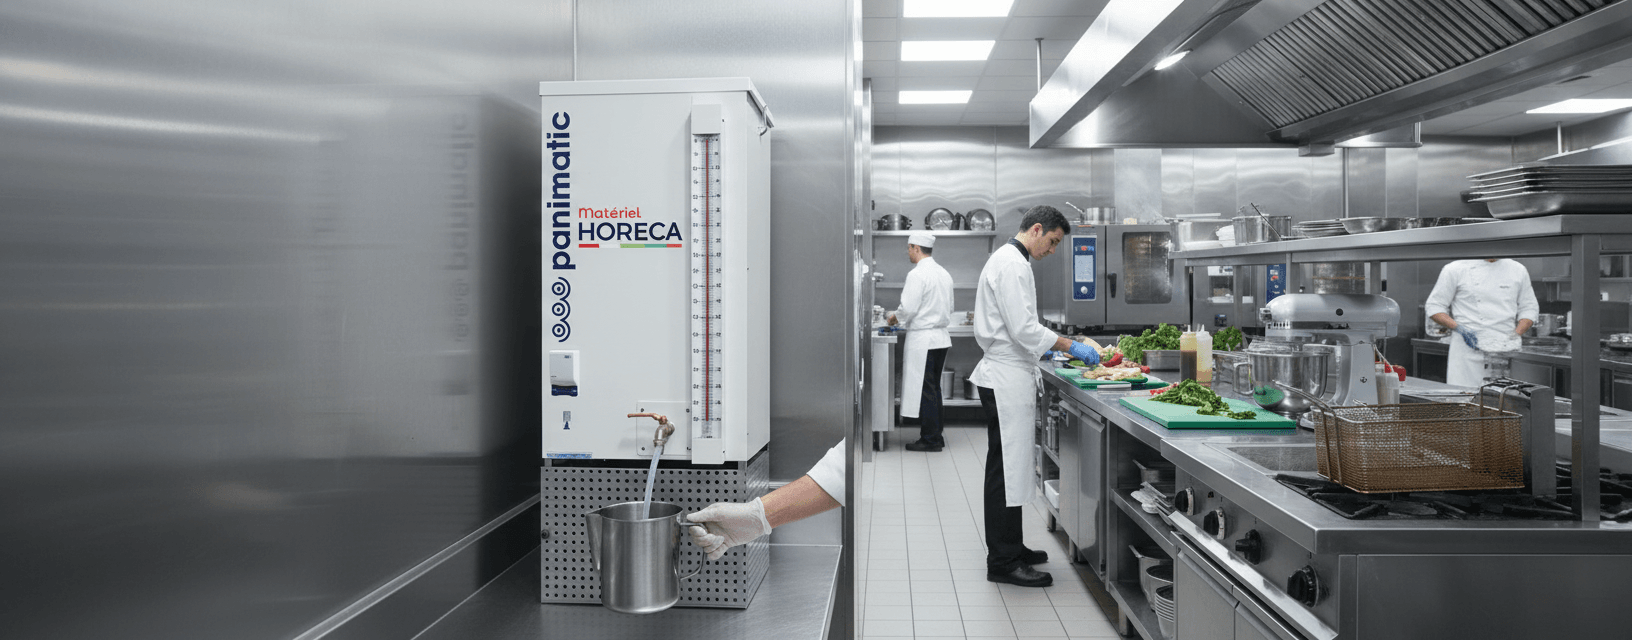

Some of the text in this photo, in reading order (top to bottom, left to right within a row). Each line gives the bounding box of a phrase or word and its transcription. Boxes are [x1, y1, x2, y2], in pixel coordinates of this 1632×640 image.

[547, 111, 576, 270] panimatic
[578, 206, 642, 219] Matériel
[578, 222, 683, 241] HORECA
